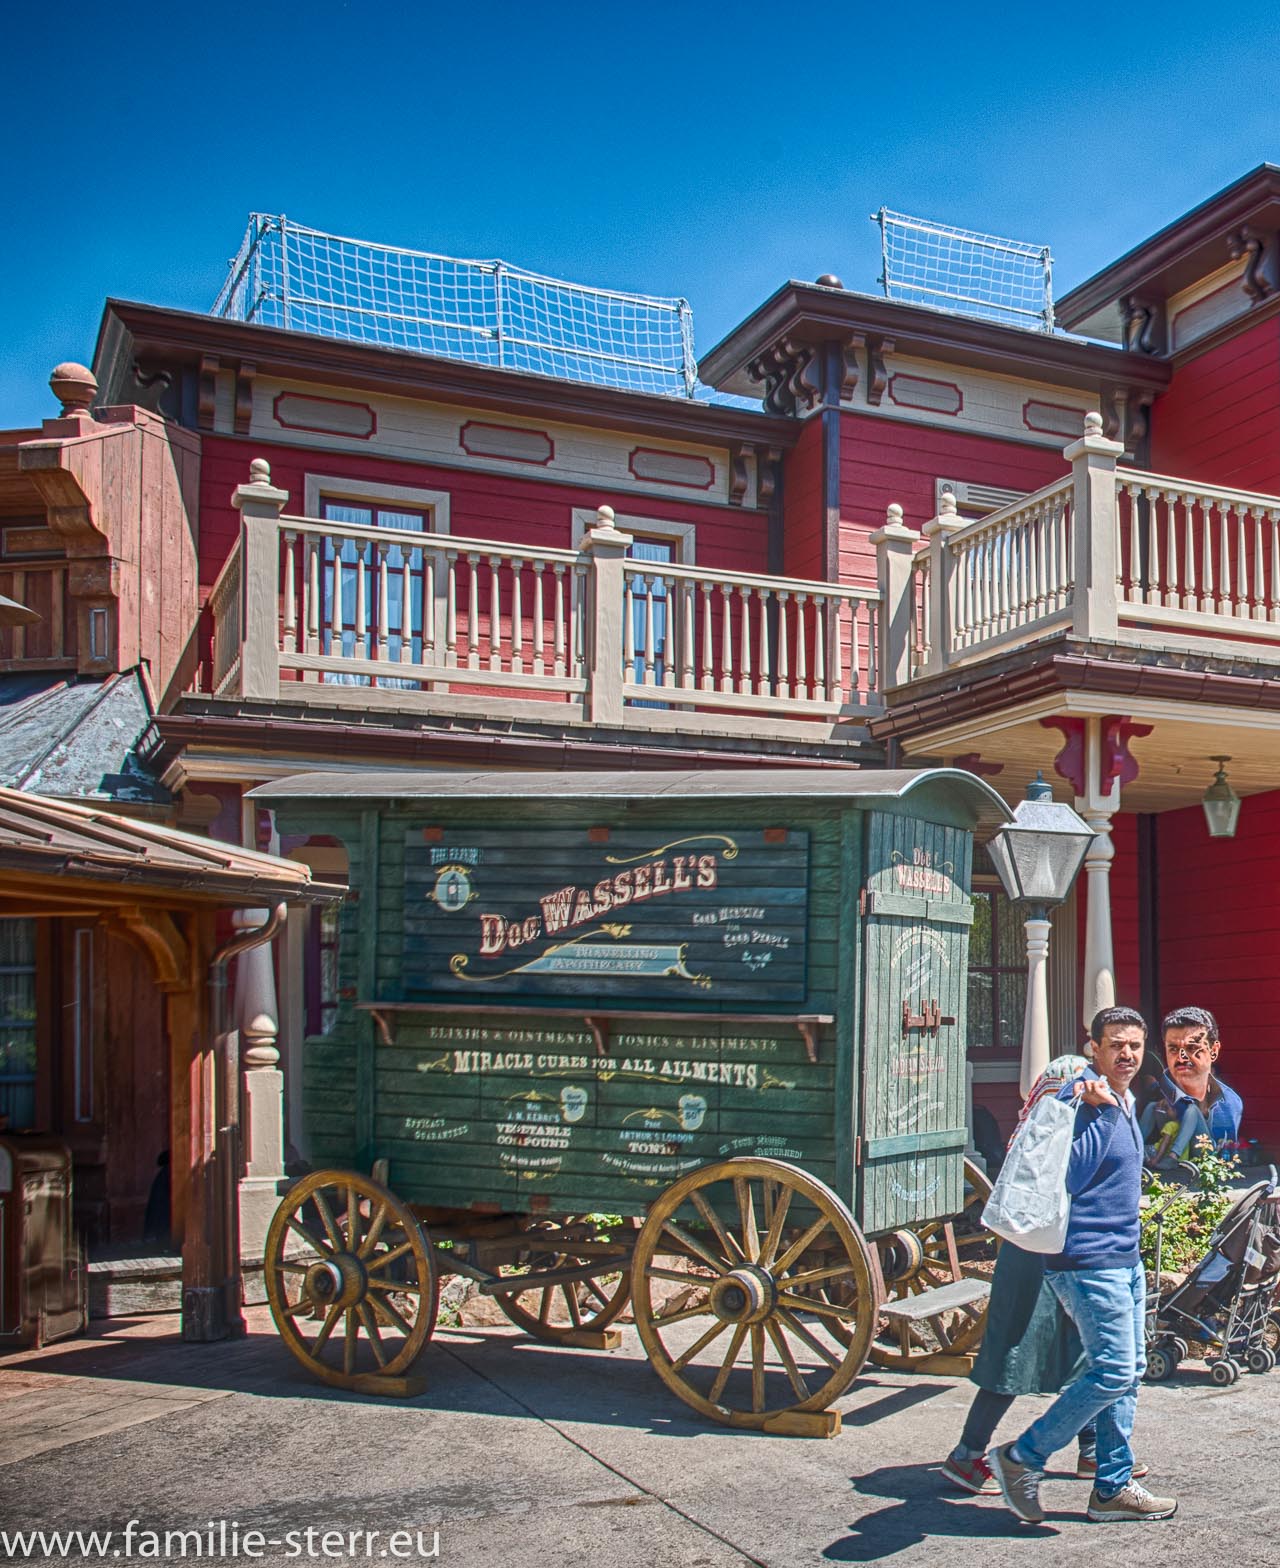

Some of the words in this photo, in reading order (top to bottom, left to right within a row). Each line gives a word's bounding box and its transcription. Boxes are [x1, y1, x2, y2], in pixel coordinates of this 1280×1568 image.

[539, 854, 718, 936] WASSELL'S
[508, 1030, 593, 1045] OINTMENTS
[617, 1034, 669, 1048] TONICS
[454, 1050, 533, 1073] MIRACLE
[537, 1054, 588, 1069] CURES
[621, 1058, 655, 1073] ALL
[660, 1060, 758, 1089] AILMENTS
